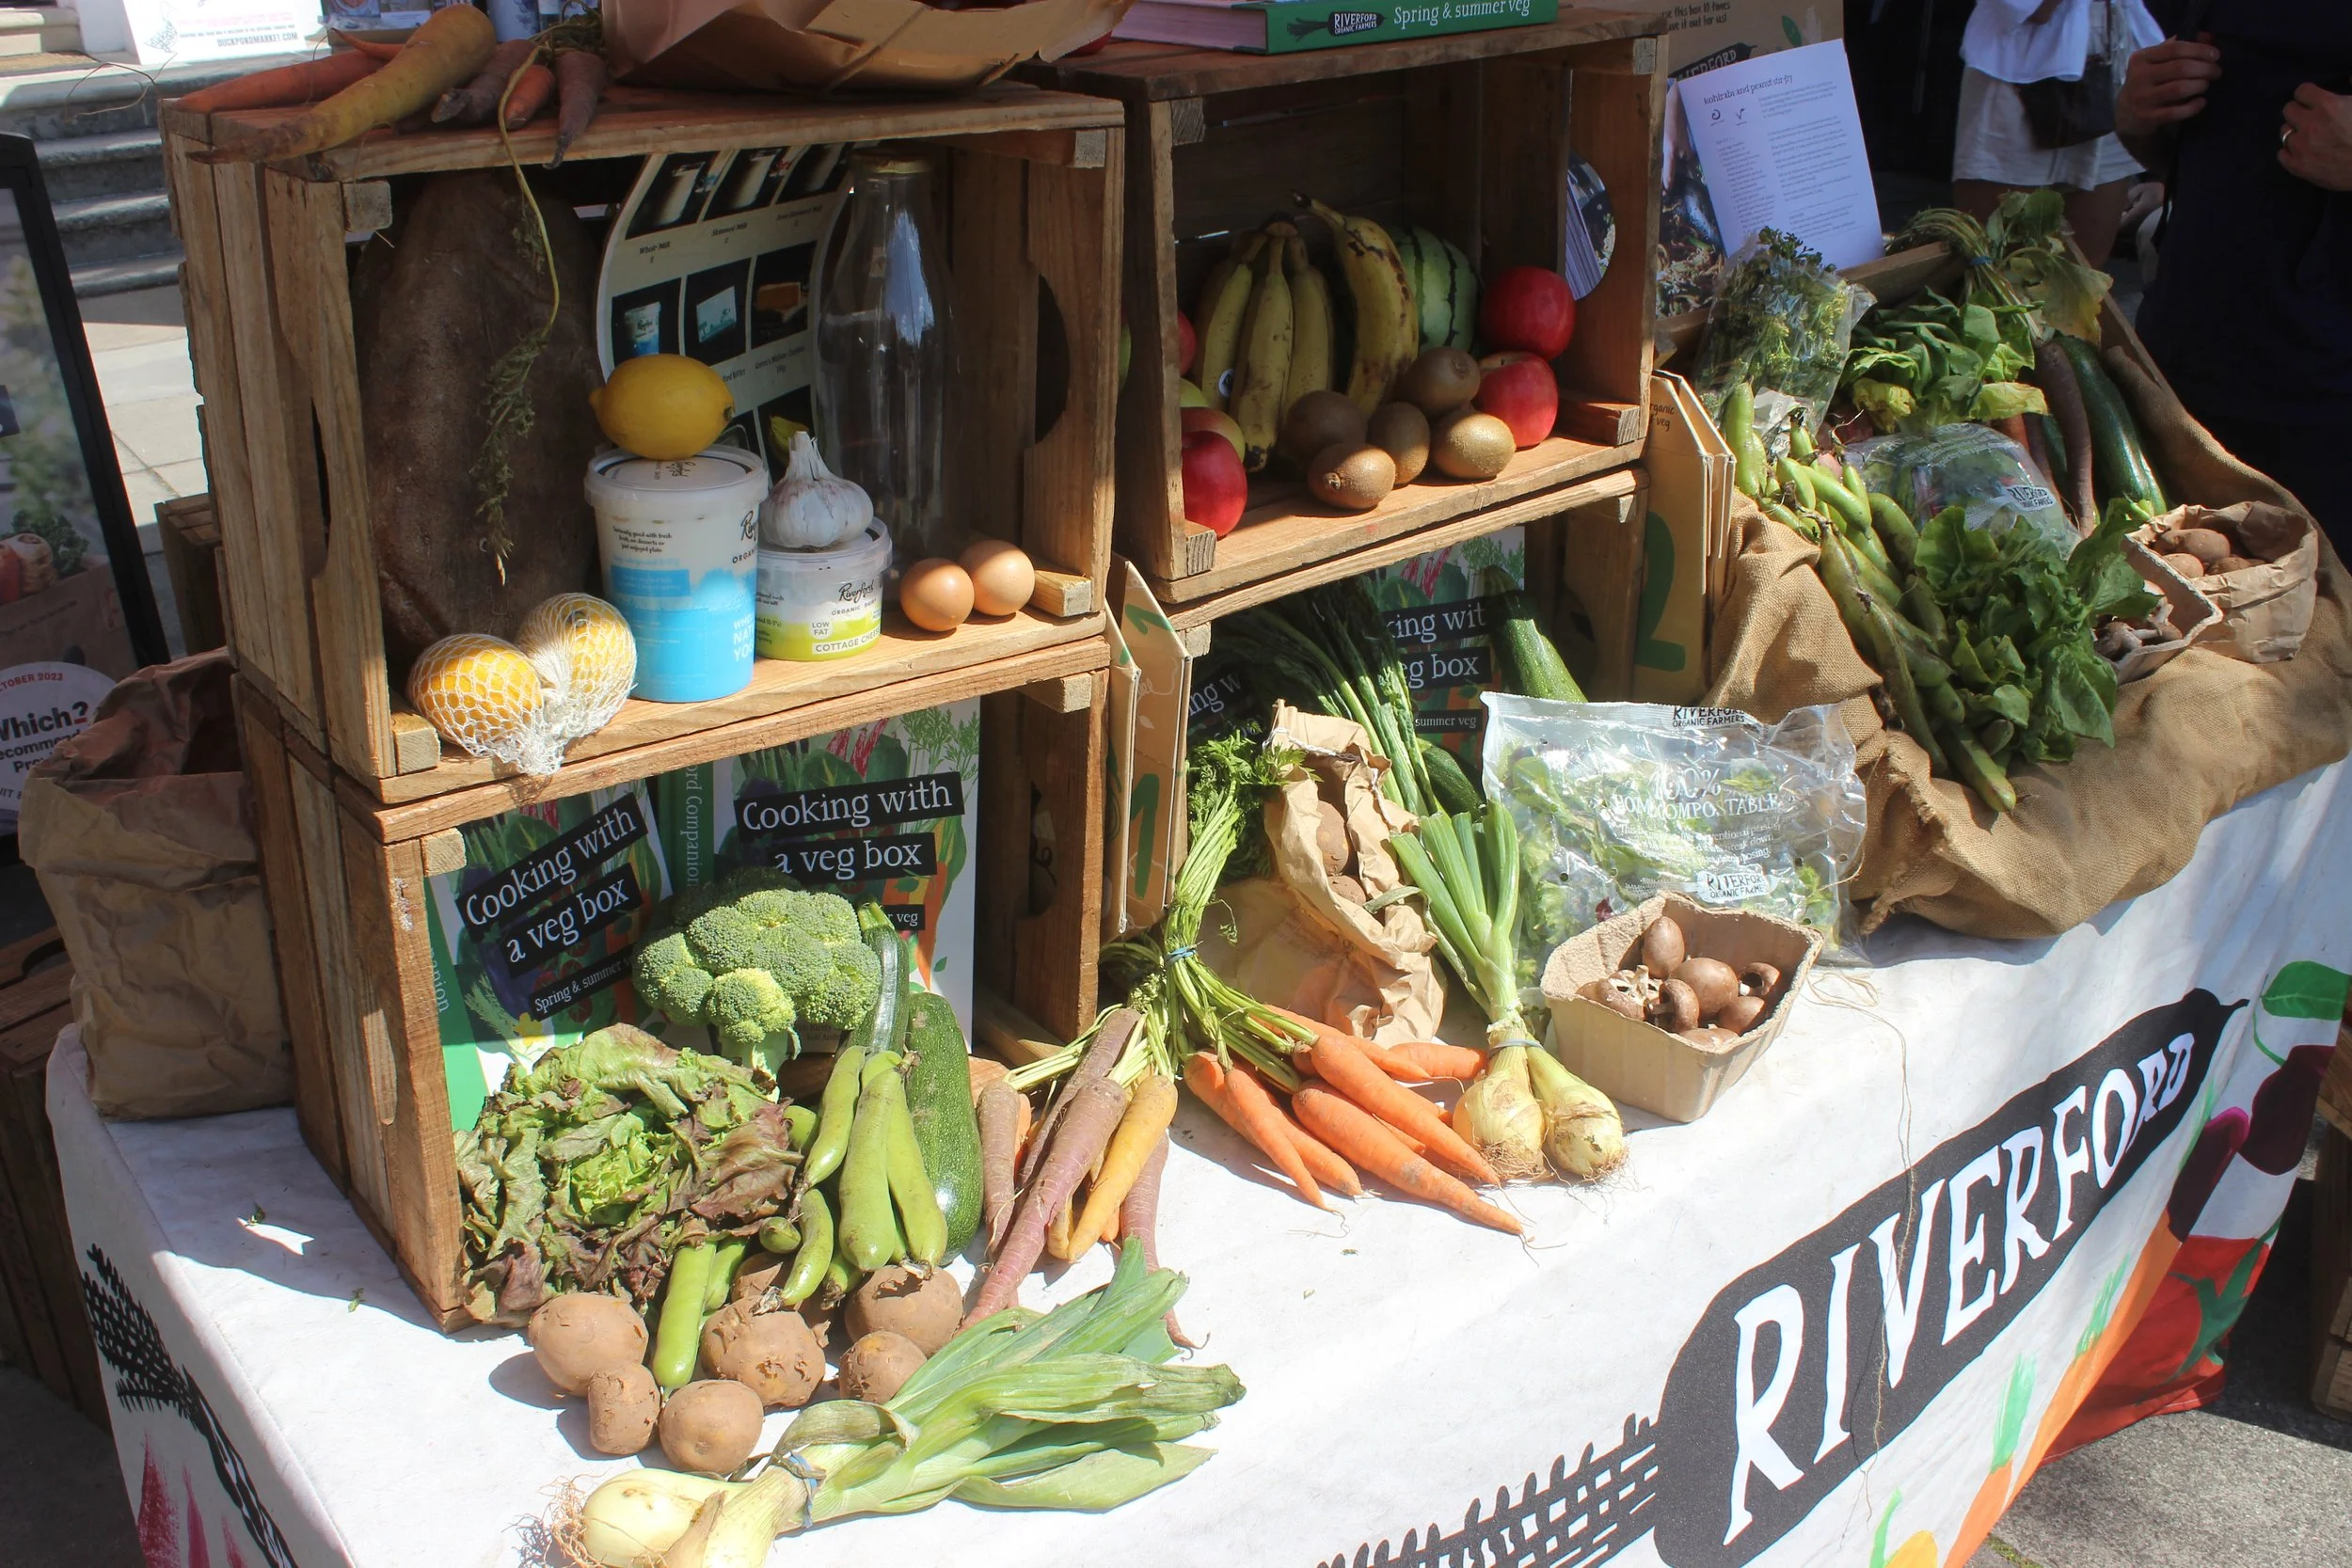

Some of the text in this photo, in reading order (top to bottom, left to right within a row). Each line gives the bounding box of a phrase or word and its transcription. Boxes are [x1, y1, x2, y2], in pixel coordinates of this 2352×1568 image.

[1393, 0, 1530, 30] Spring & summer veg
[1689, 4, 1702, 16] box
[1334, 13, 1377, 28] RIVERFORD
[1334, 21, 1377, 35] ORGANIC FARMERS
[1689, 16, 1702, 28] out
[1703, 89, 1735, 105] kohlrabi
[1736, 85, 1750, 95] and
[1749, 79, 1772, 95] peanut
[1656, 417, 1671, 433] veg
[838, 579, 875, 603] Riverford
[831, 605, 861, 617] ORGANIC
[815, 638, 859, 654] COTTAGE
[1431, 653, 1480, 679] box
[38, 672, 64, 682] 2023
[1414, 716, 1477, 729] summer veg
[1672, 714, 1745, 728] ORGANIC FARMERS
[742, 779, 953, 831] Cooking with
[466, 807, 637, 926] Cooking with
[774, 839, 923, 881] a veg box
[505, 879, 630, 963] a veg box
[896, 912, 919, 927] veg
[533, 986, 572, 1014] Spring
[571, 981, 581, 992] &
[582, 960, 623, 988] summer
[1724, 1031, 2199, 1546] RIVERFORD
